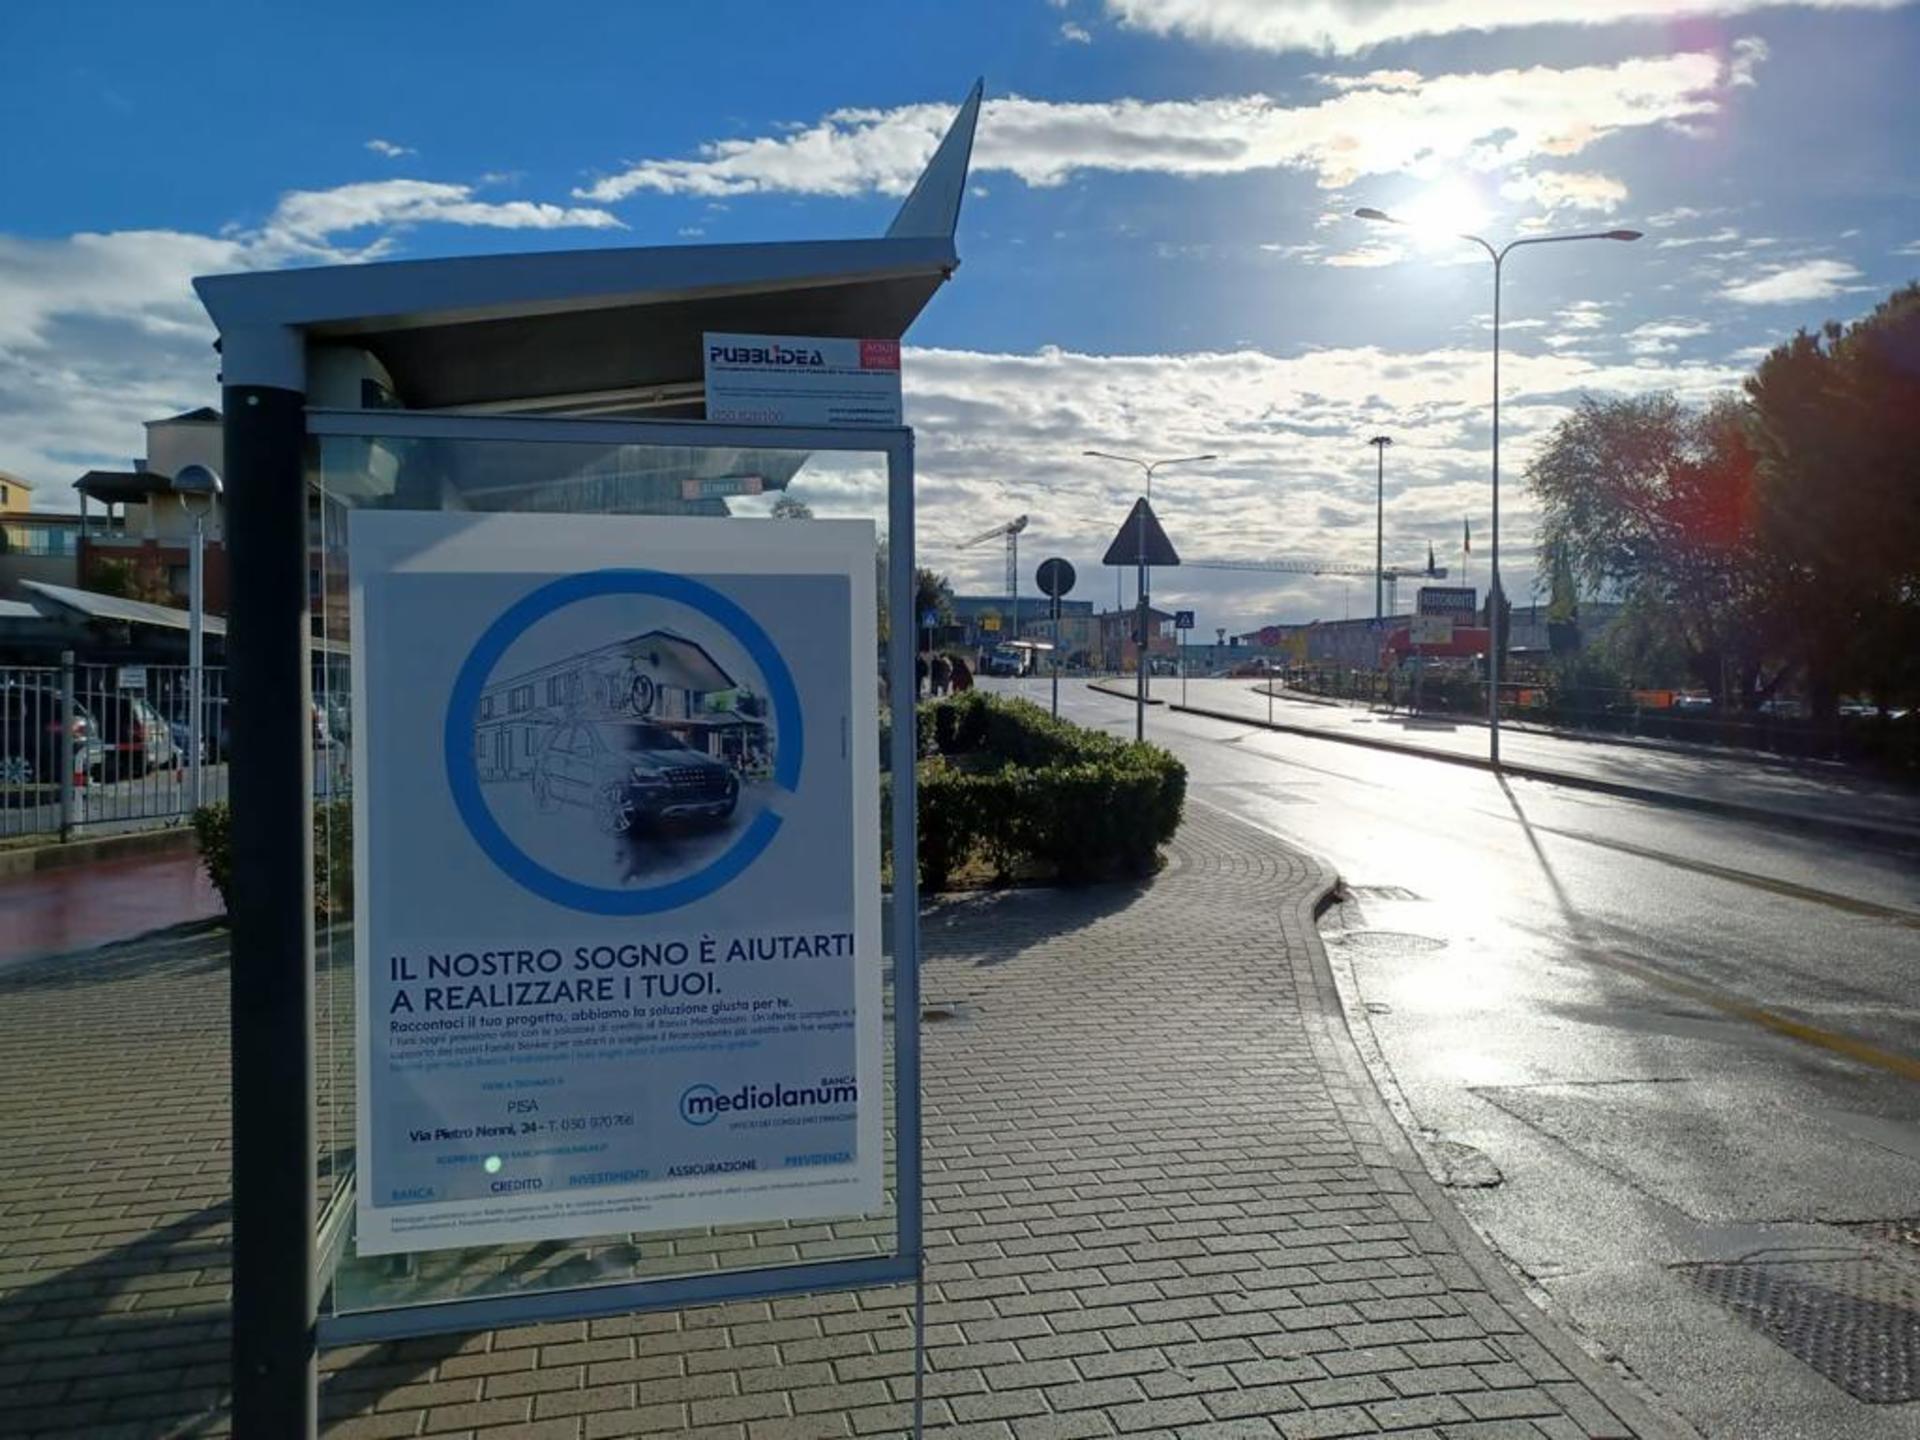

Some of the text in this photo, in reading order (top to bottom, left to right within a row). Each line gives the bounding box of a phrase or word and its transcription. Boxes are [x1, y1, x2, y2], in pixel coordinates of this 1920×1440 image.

[390, 932, 854, 982] IL NOSTRO SOGNO È AIUTARTI
[389, 971, 722, 1015] A REALIZZARE I TUOI.
[390, 1017, 464, 1033] Raccontaci
[468, 1014, 476, 1028] il
[480, 1013, 502, 1027] tuo
[506, 1010, 568, 1029] progetto,
[571, 1007, 629, 1023] abbiamo
[633, 1006, 646, 1018] la
[649, 1001, 708, 1017] soluzione
[711, 1000, 749, 1016] giusta
[752, 999, 773, 1014] per
[507, 1098, 540, 1114] PISA
[687, 1081, 858, 1116] mediolanum
[409, 1129, 433, 1144] Via
[435, 1126, 474, 1142] Pietro
[666, 1158, 759, 1178] ASSICURAZIONE
[490, 1177, 544, 1193] CREDITO
